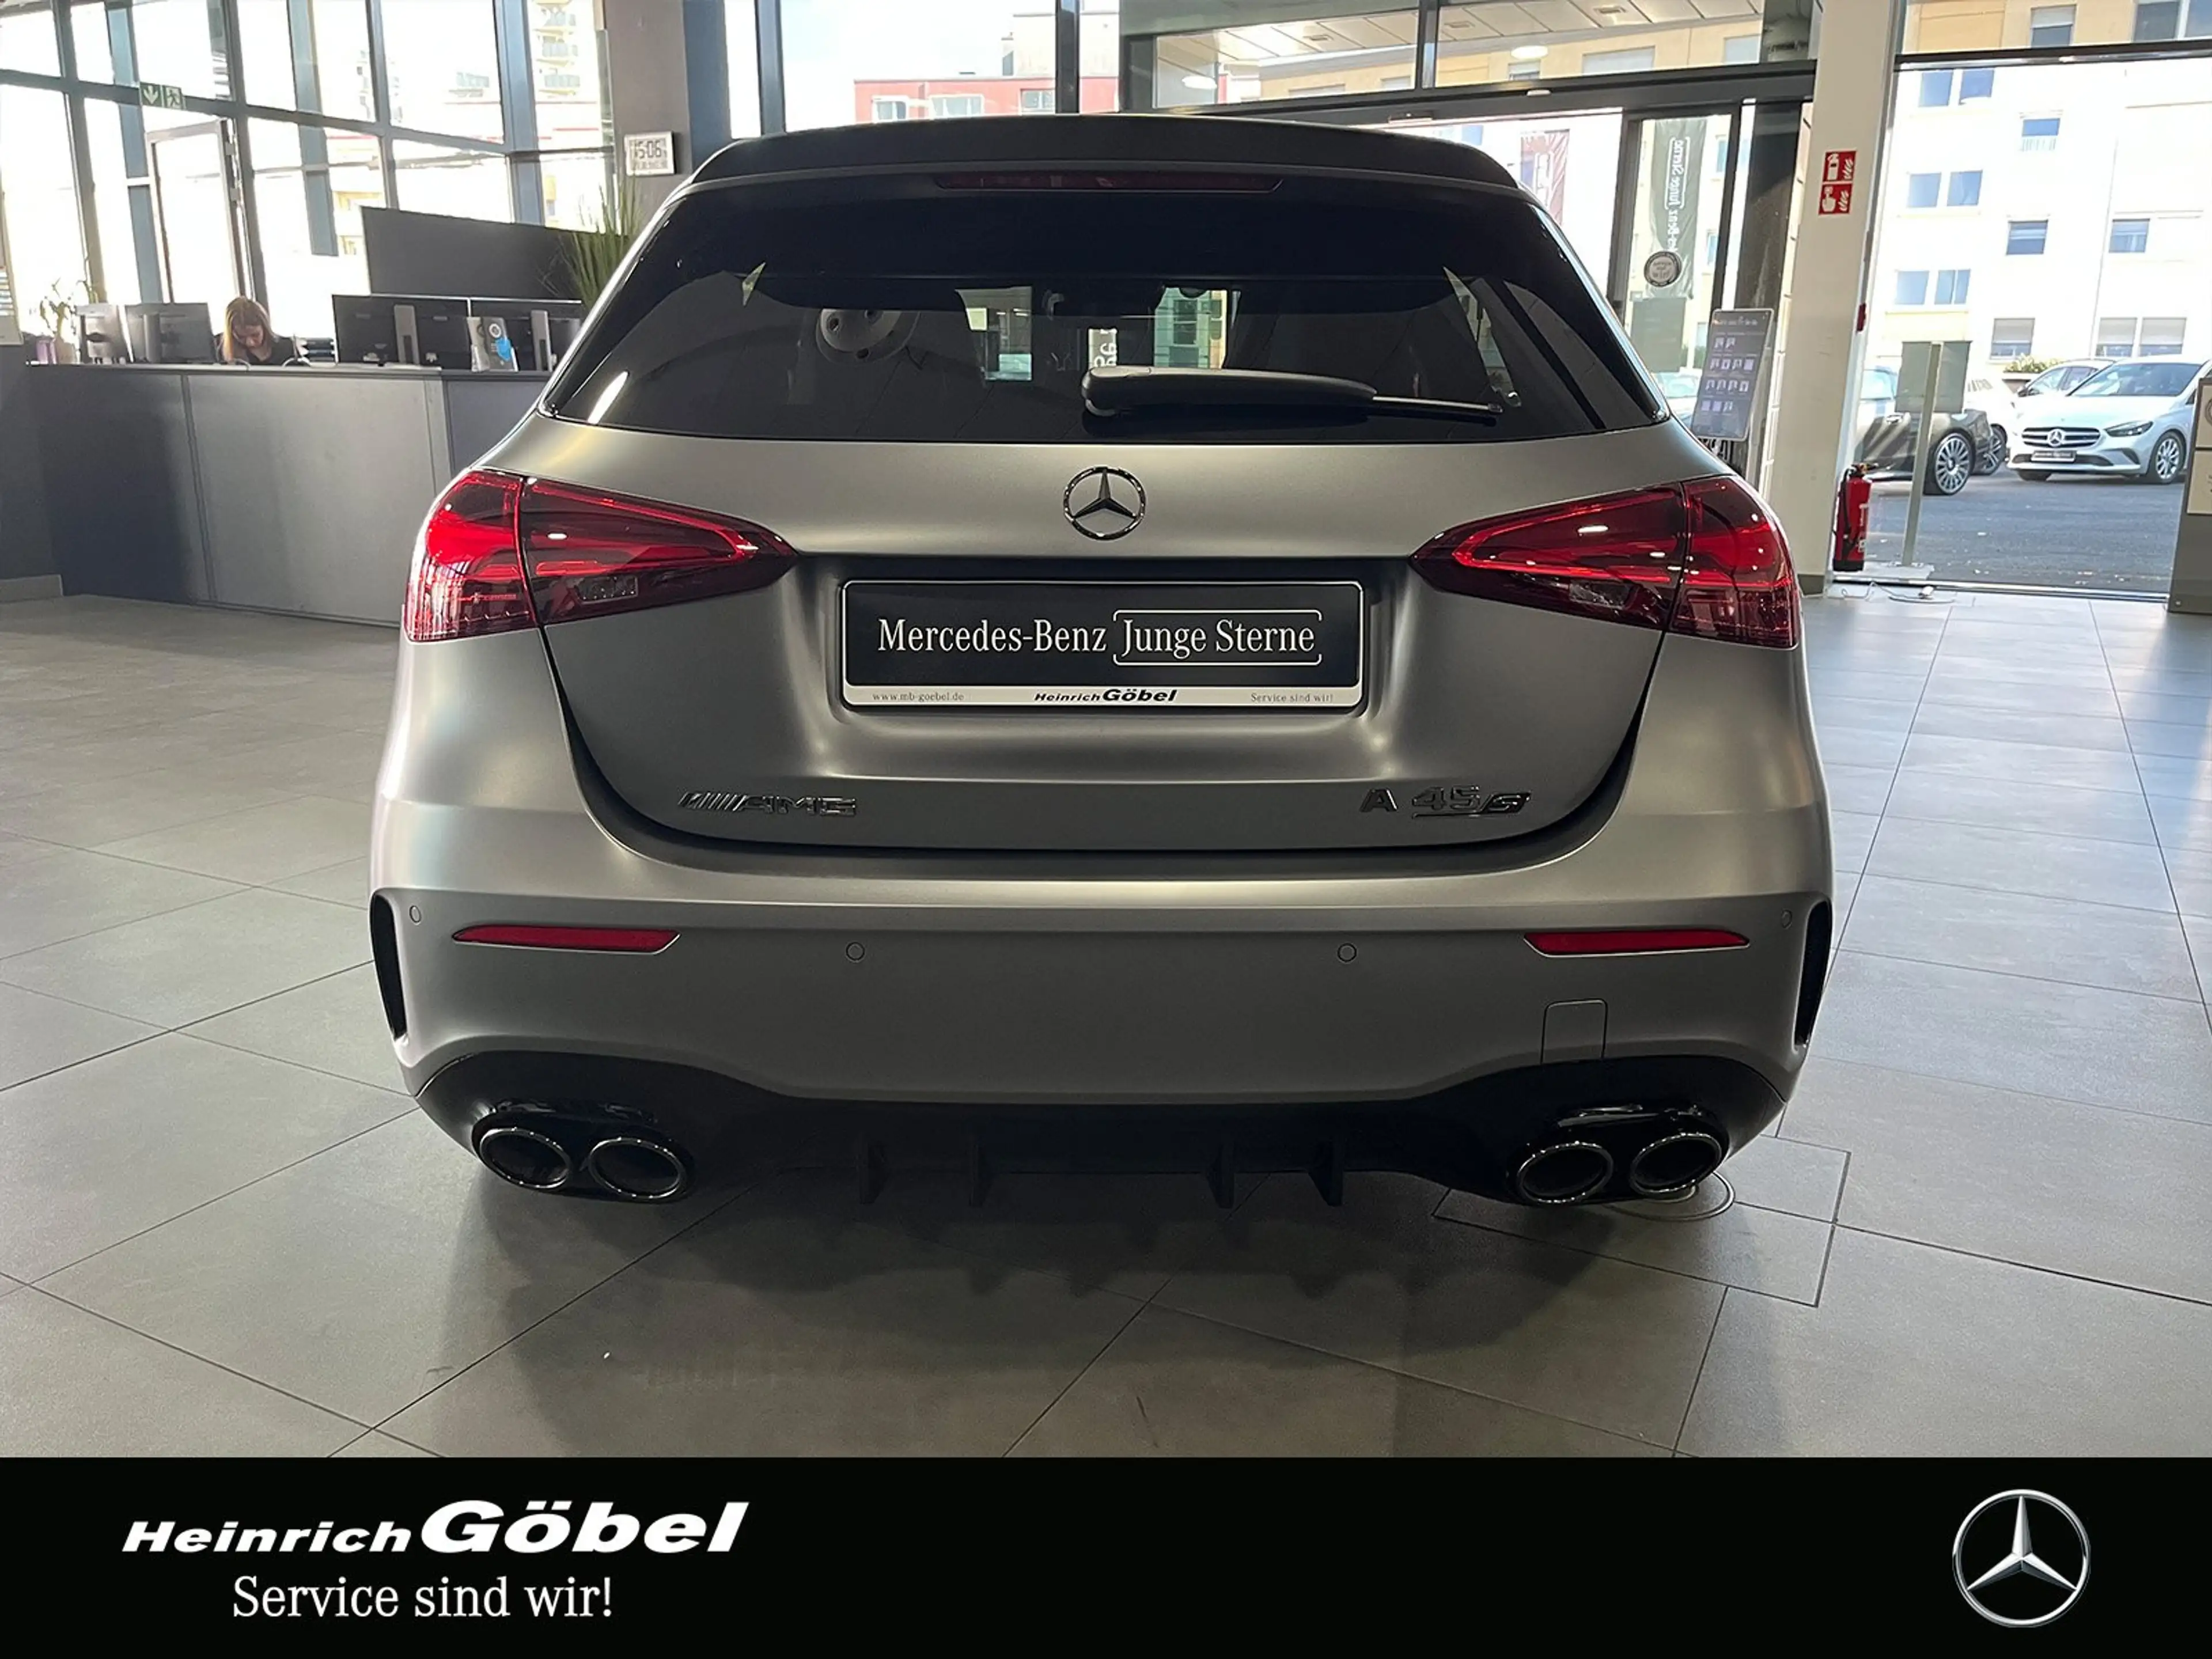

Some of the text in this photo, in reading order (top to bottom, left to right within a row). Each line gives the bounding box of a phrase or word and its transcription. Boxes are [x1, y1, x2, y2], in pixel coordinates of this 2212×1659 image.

[877, 618, 1315, 660] Mercedes-Benz Junge Sterne
[872, 691, 965, 702] www.mb-goebel.de
[1034, 688, 1178, 702] Heinrich Göbel
[1251, 692, 1287, 703] Service
[1290, 693, 1310, 702] sind
[1358, 787, 1400, 813] A
